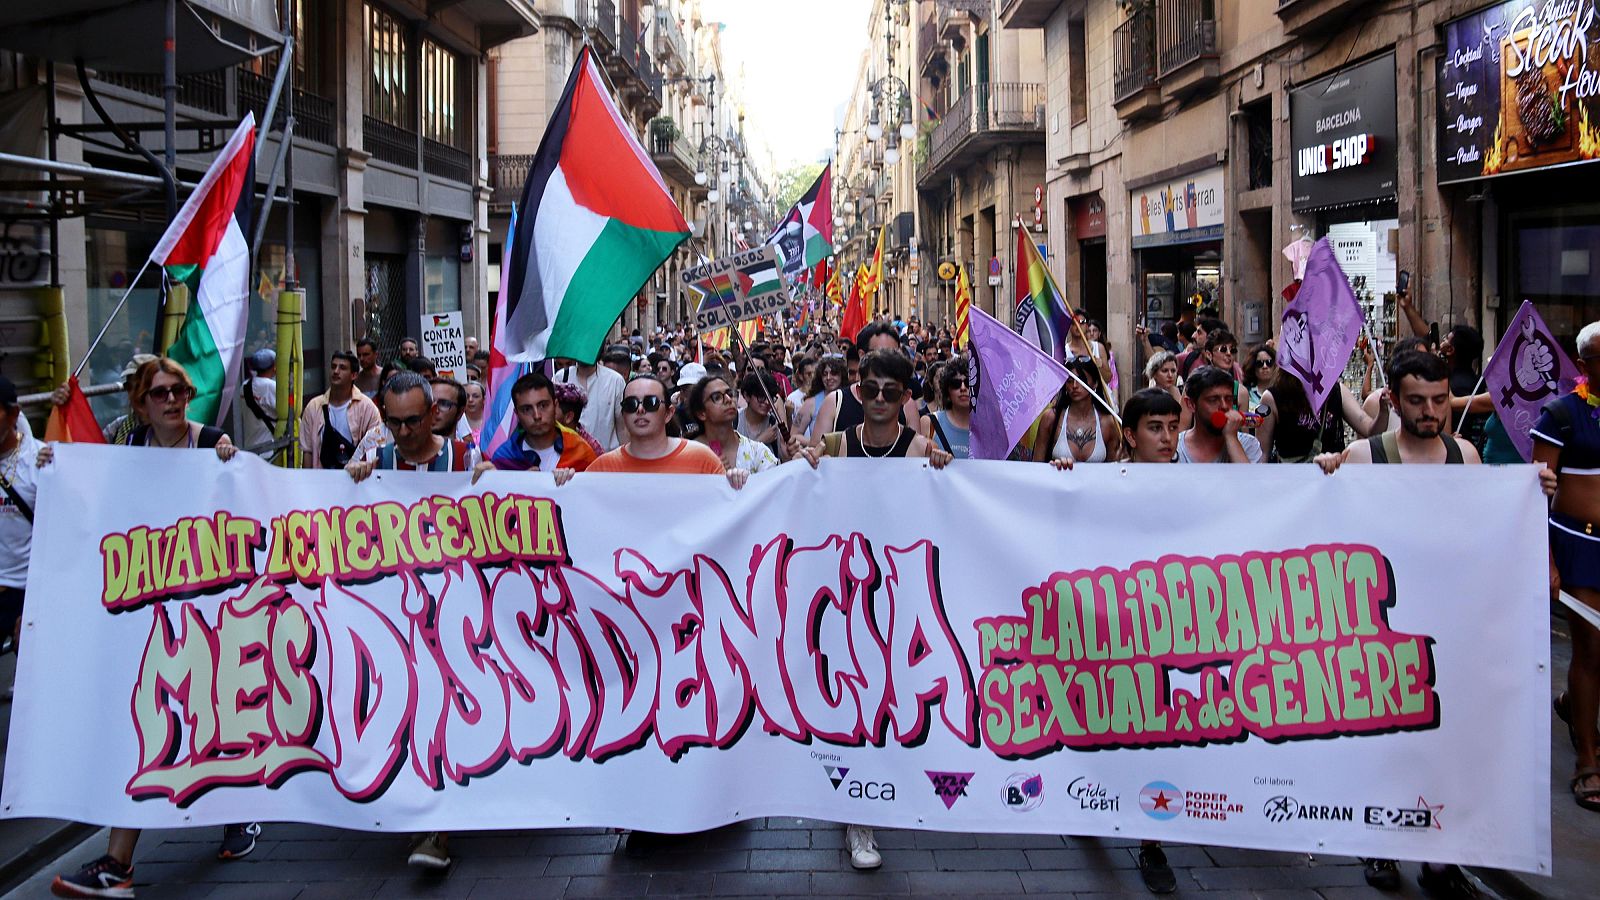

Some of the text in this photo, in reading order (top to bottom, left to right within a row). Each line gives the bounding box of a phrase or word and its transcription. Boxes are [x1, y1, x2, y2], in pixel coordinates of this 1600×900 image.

[1507, 0, 1594, 77] Steak
[1454, 43, 1484, 71] Cocktail
[1456, 81, 1479, 104] Tapas
[1316, 107, 1361, 133] BARCELONA
[1457, 114, 1484, 135] Burger
[1298, 133, 1368, 177] UNIQ SHOP
[1457, 146, 1480, 165] Paella
[424, 327, 461, 342] CONTRA
[430, 341, 456, 354] TOTA
[101, 492, 568, 610] DAVANT L'EMERGÈNCIA
[977, 620, 1029, 667] per
[128, 575, 325, 799] MÉS
[981, 637, 1427, 747] SEXUAL i de GÈNERE
[1067, 776, 1107, 801] Crida
[1185, 791, 1228, 802] PODER
[1185, 800, 1244, 813] POPULAR
[1185, 809, 1227, 821] TRANS
[1298, 805, 1353, 821] ARRAN
